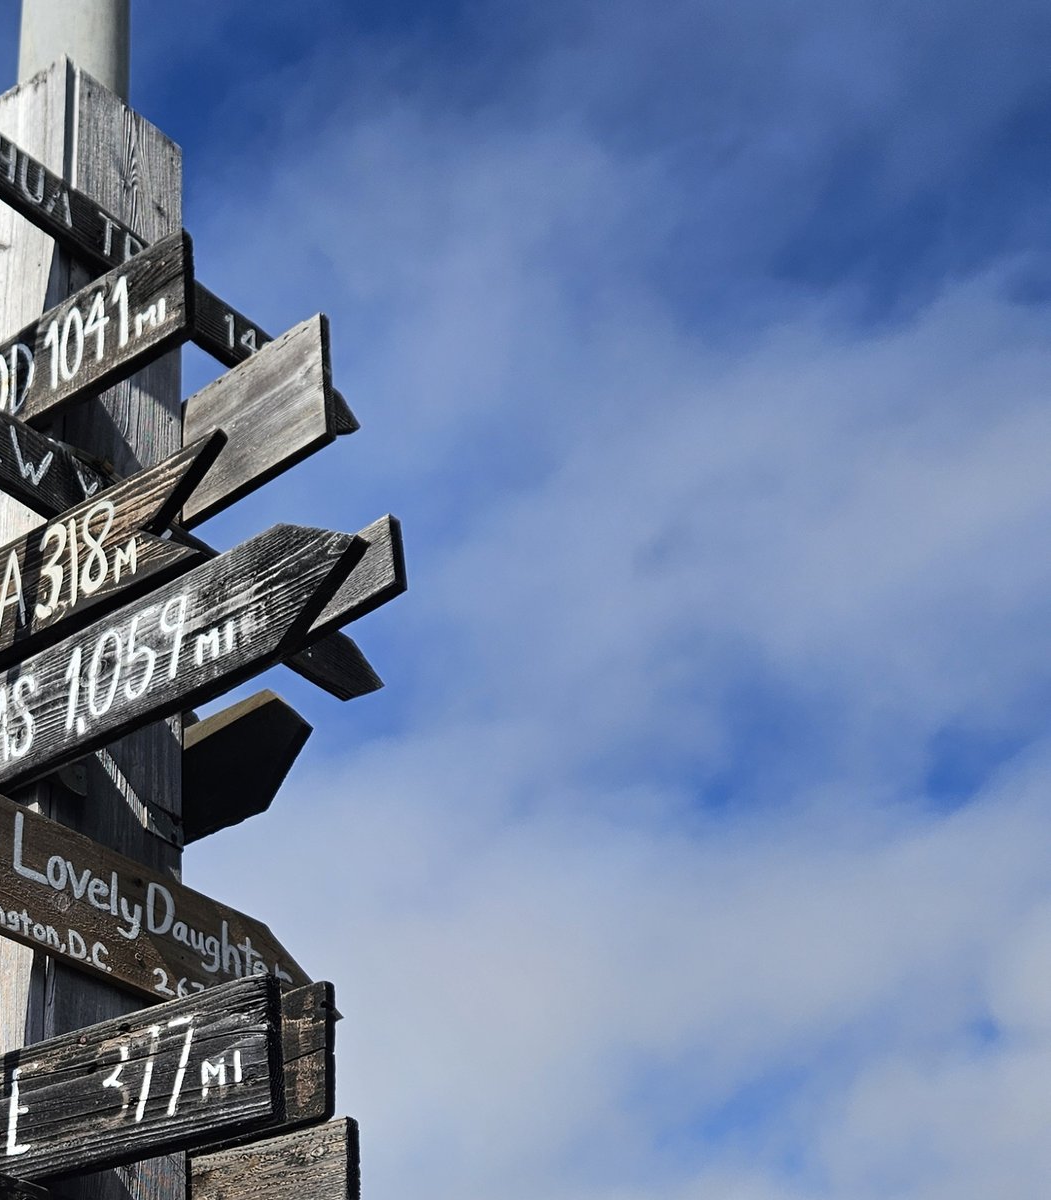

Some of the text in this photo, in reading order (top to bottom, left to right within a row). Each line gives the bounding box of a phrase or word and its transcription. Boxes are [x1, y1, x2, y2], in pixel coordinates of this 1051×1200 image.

[44, 275, 129, 390] 1041
[35, 501, 115, 619] 318
[13, 811, 143, 941] Lovely
